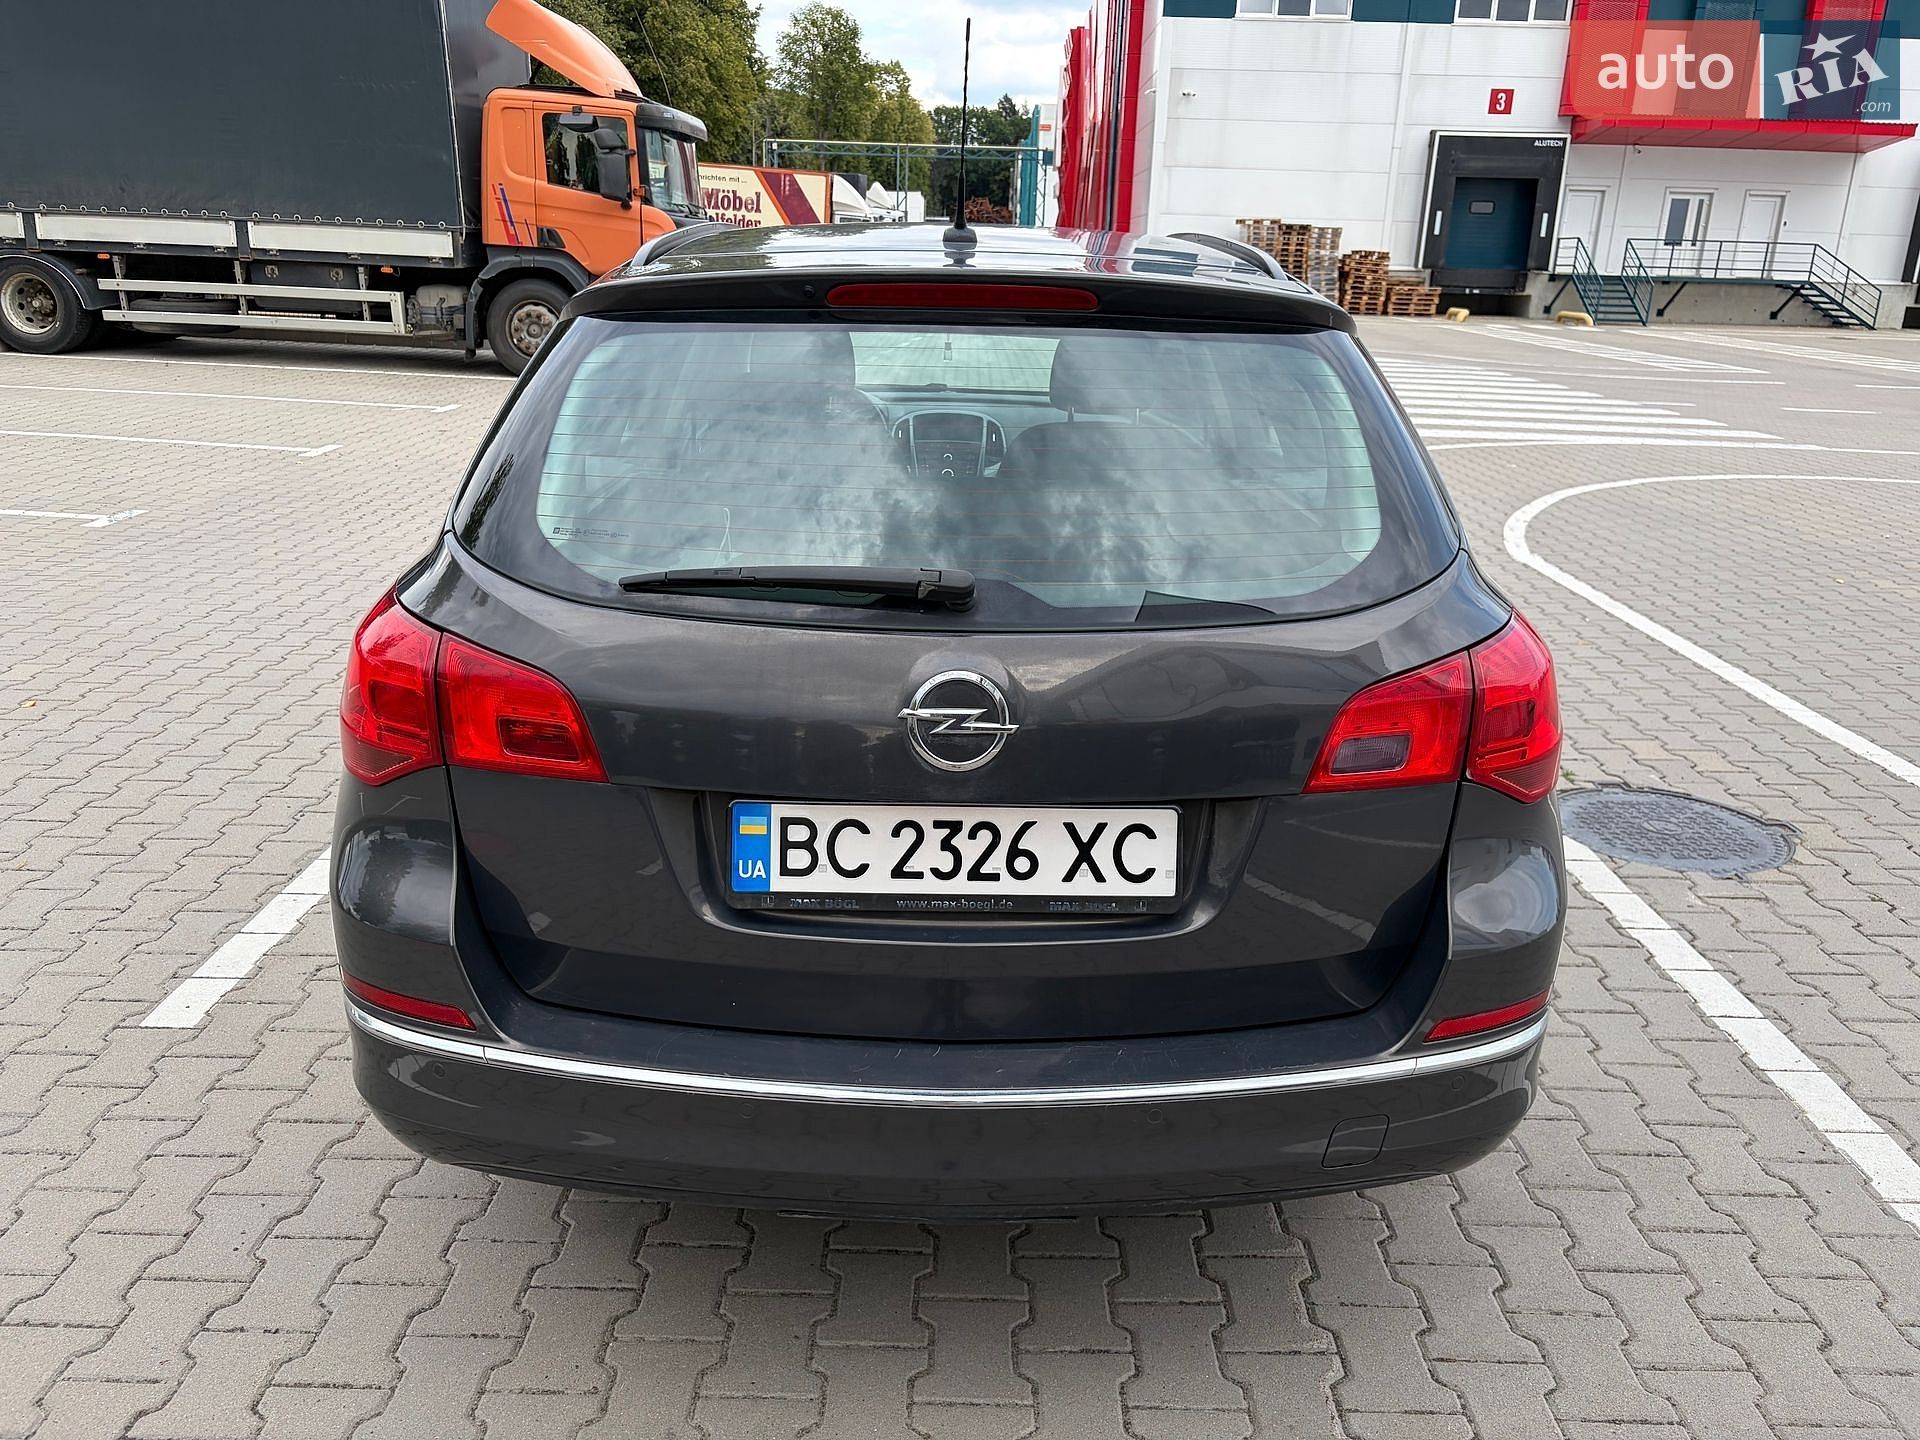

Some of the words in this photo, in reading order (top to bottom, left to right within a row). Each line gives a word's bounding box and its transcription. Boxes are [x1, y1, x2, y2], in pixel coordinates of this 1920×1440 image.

[1495, 91, 1506, 112] 3
[701, 187, 762, 214] Möbel
[778, 816, 871, 879] BC
[890, 819, 1040, 882] 2326
[1061, 821, 1159, 883] XC
[738, 859, 767, 880] UA
[896, 898, 1014, 911] www.max-boegl.de
